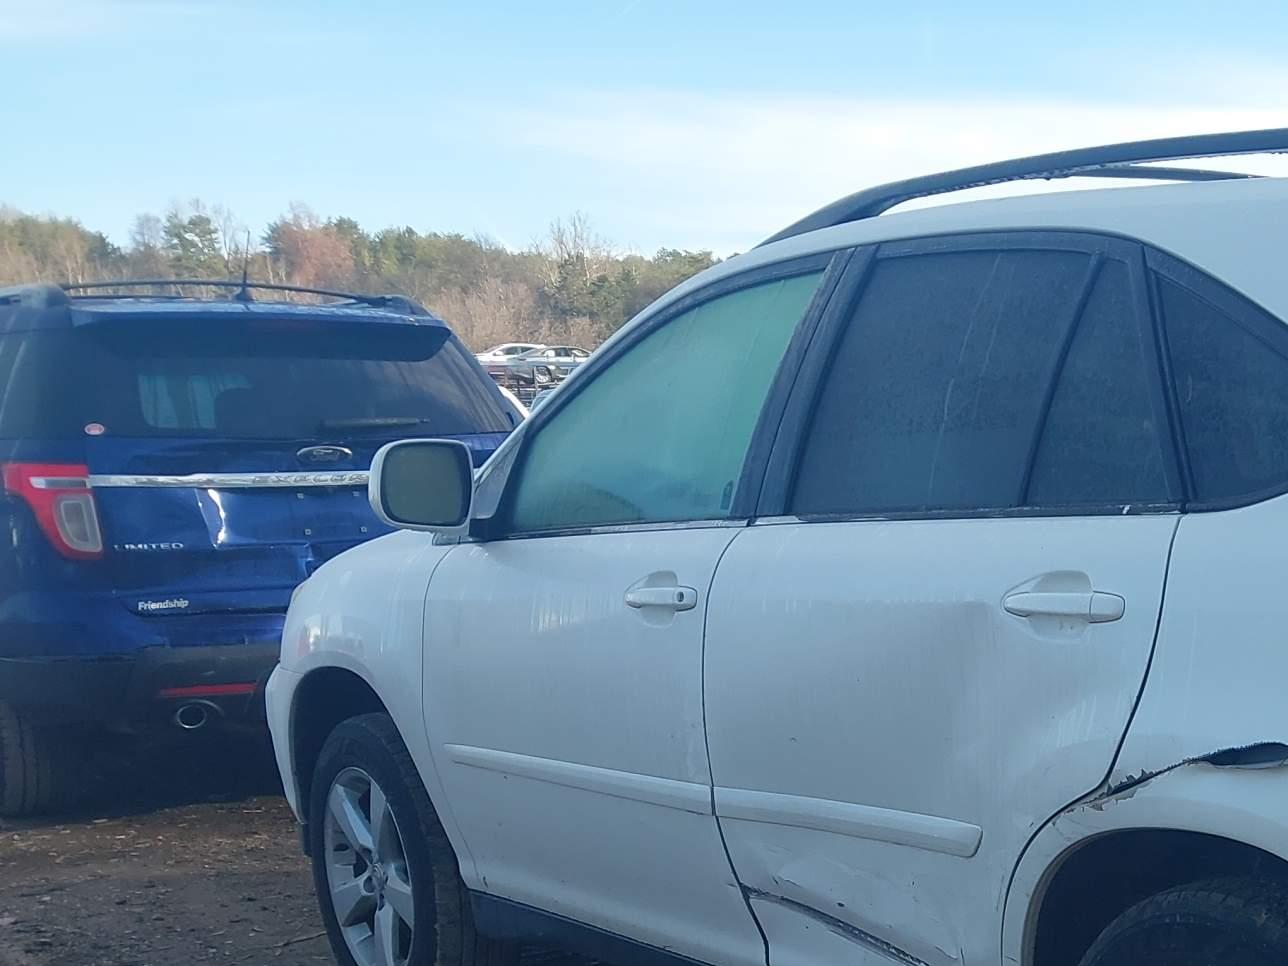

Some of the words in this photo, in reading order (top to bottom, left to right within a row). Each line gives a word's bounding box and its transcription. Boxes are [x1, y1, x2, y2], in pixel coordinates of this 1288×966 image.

[252, 473, 370, 485] EXPLOR
[112, 541, 185, 551] LIMITED
[137, 598, 190, 611] Friendship
